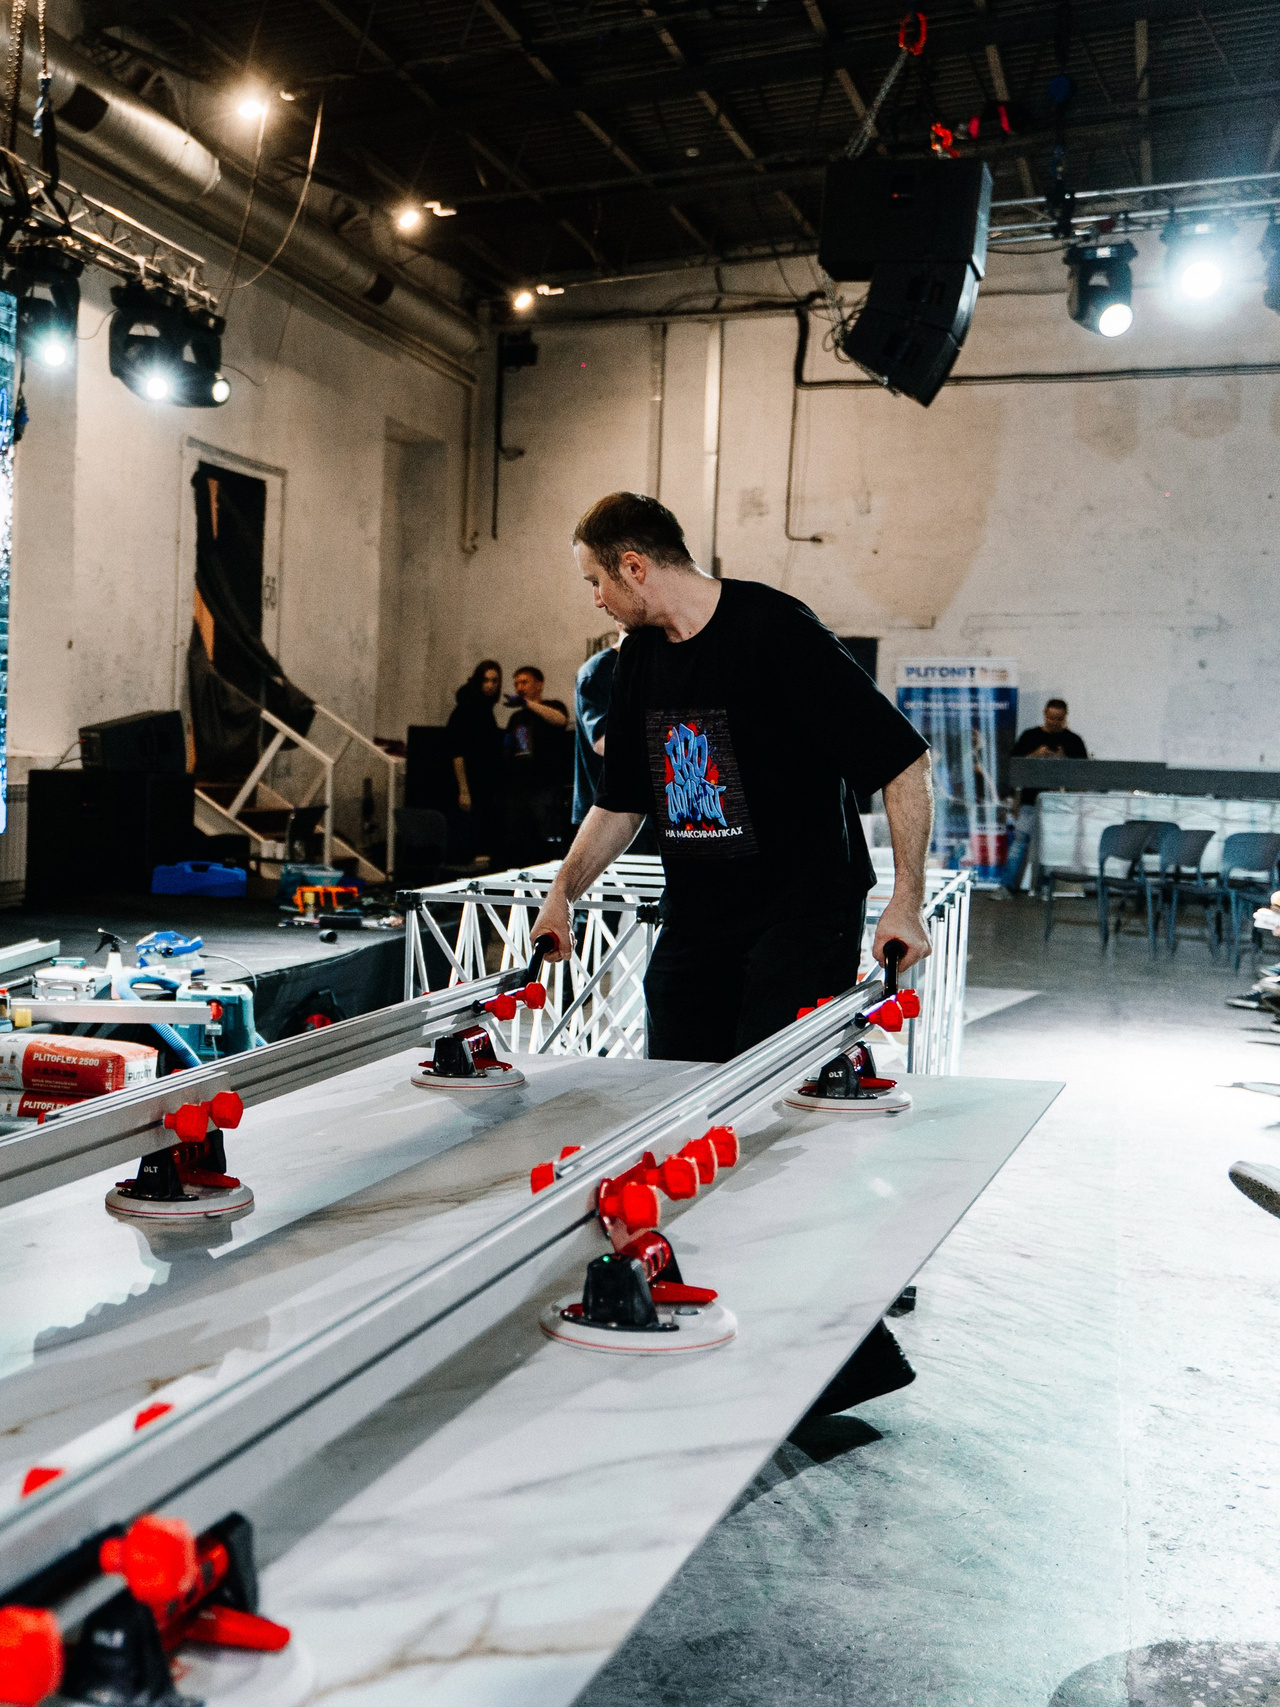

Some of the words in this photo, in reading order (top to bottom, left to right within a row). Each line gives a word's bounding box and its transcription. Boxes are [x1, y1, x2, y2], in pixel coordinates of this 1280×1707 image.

[905, 667, 976, 678] PLITONIT
[663, 722, 709, 786] PRO
[665, 829, 676, 838] НА
[676, 826, 744, 839] МАКСИМАЛКАХ
[32, 1052, 78, 1065] PLITOFLEX
[78, 1057, 100, 1067] 2500
